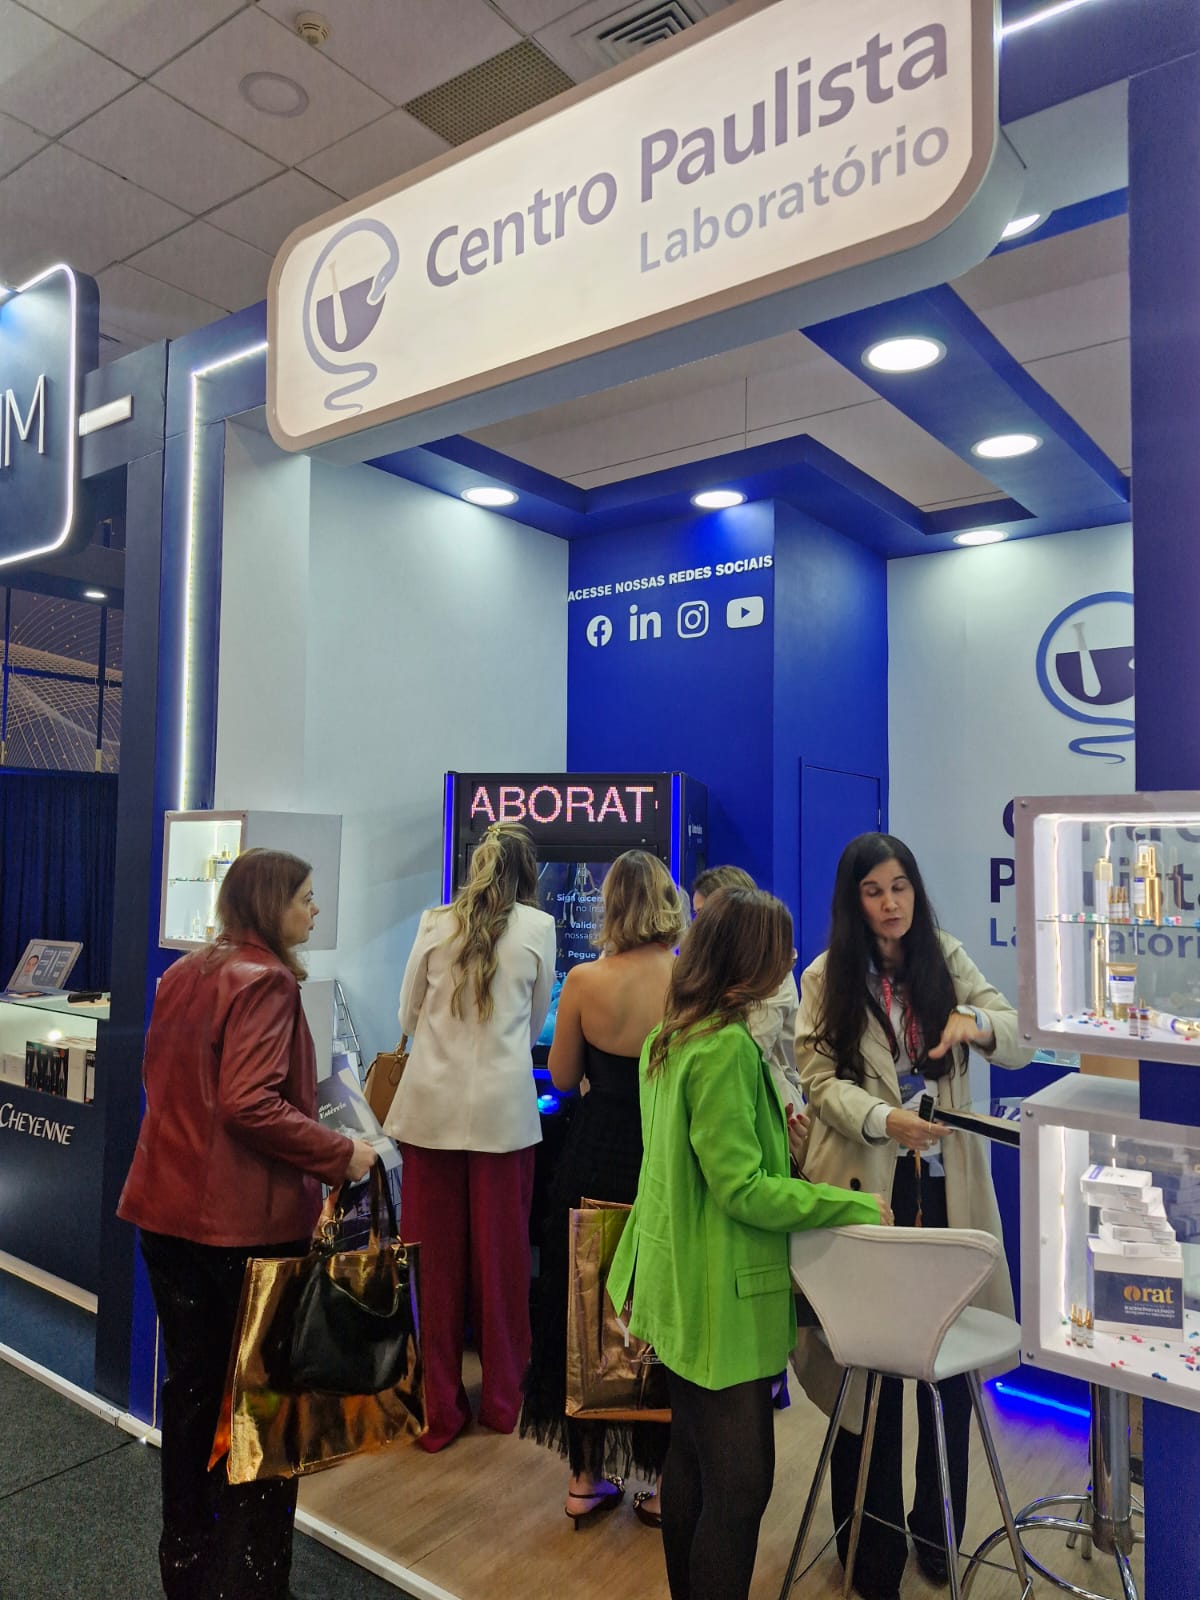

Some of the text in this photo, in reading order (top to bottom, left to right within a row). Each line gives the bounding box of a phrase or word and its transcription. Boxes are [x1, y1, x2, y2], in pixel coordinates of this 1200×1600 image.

[426, 23, 949, 288] Centro Paulista
[639, 126, 949, 273] Laboratório
[567, 555, 773, 602] ACESSE NOSSAS REDES SOCIAIS
[471, 785, 659, 823] ABORAT
[567, 950, 597, 960] Pegue
